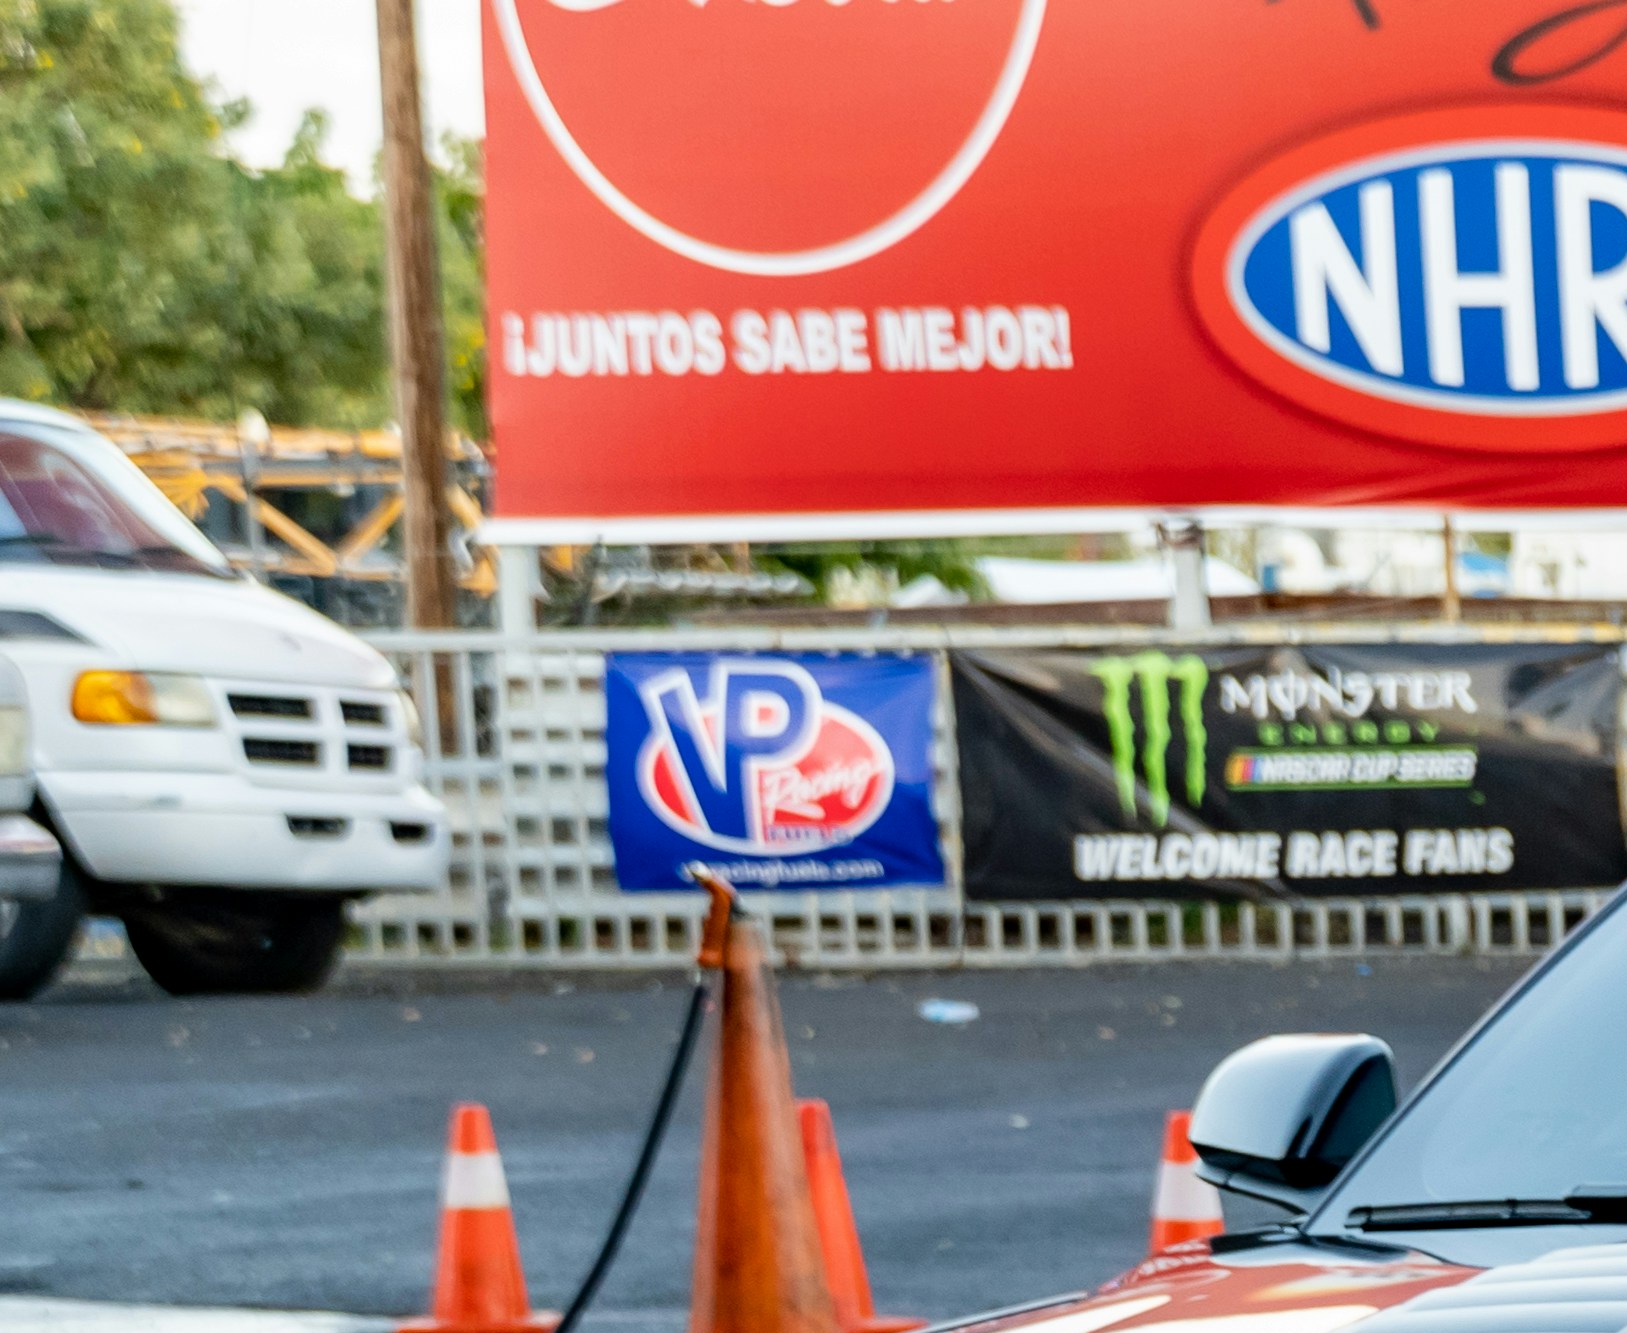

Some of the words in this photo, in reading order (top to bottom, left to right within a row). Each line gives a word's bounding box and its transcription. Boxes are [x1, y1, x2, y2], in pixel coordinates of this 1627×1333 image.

[501, 308, 726, 378] ¡JUNTOS
[731, 308, 872, 376] SABE
[876, 305, 1074, 373] MEJOR!
[1219, 664, 1479, 720] MONSTER
[640, 657, 826, 848] VP
[1256, 719, 1440, 746] ENERGY
[763, 757, 878, 818] Racing
[1263, 754, 1349, 783] NASCAR
[1350, 753, 1399, 783] CUP
[1398, 750, 1477, 781] SERIES
[1073, 831, 1282, 881] WELCOME
[1284, 829, 1399, 879] RACE
[1402, 826, 1515, 877] FANS
